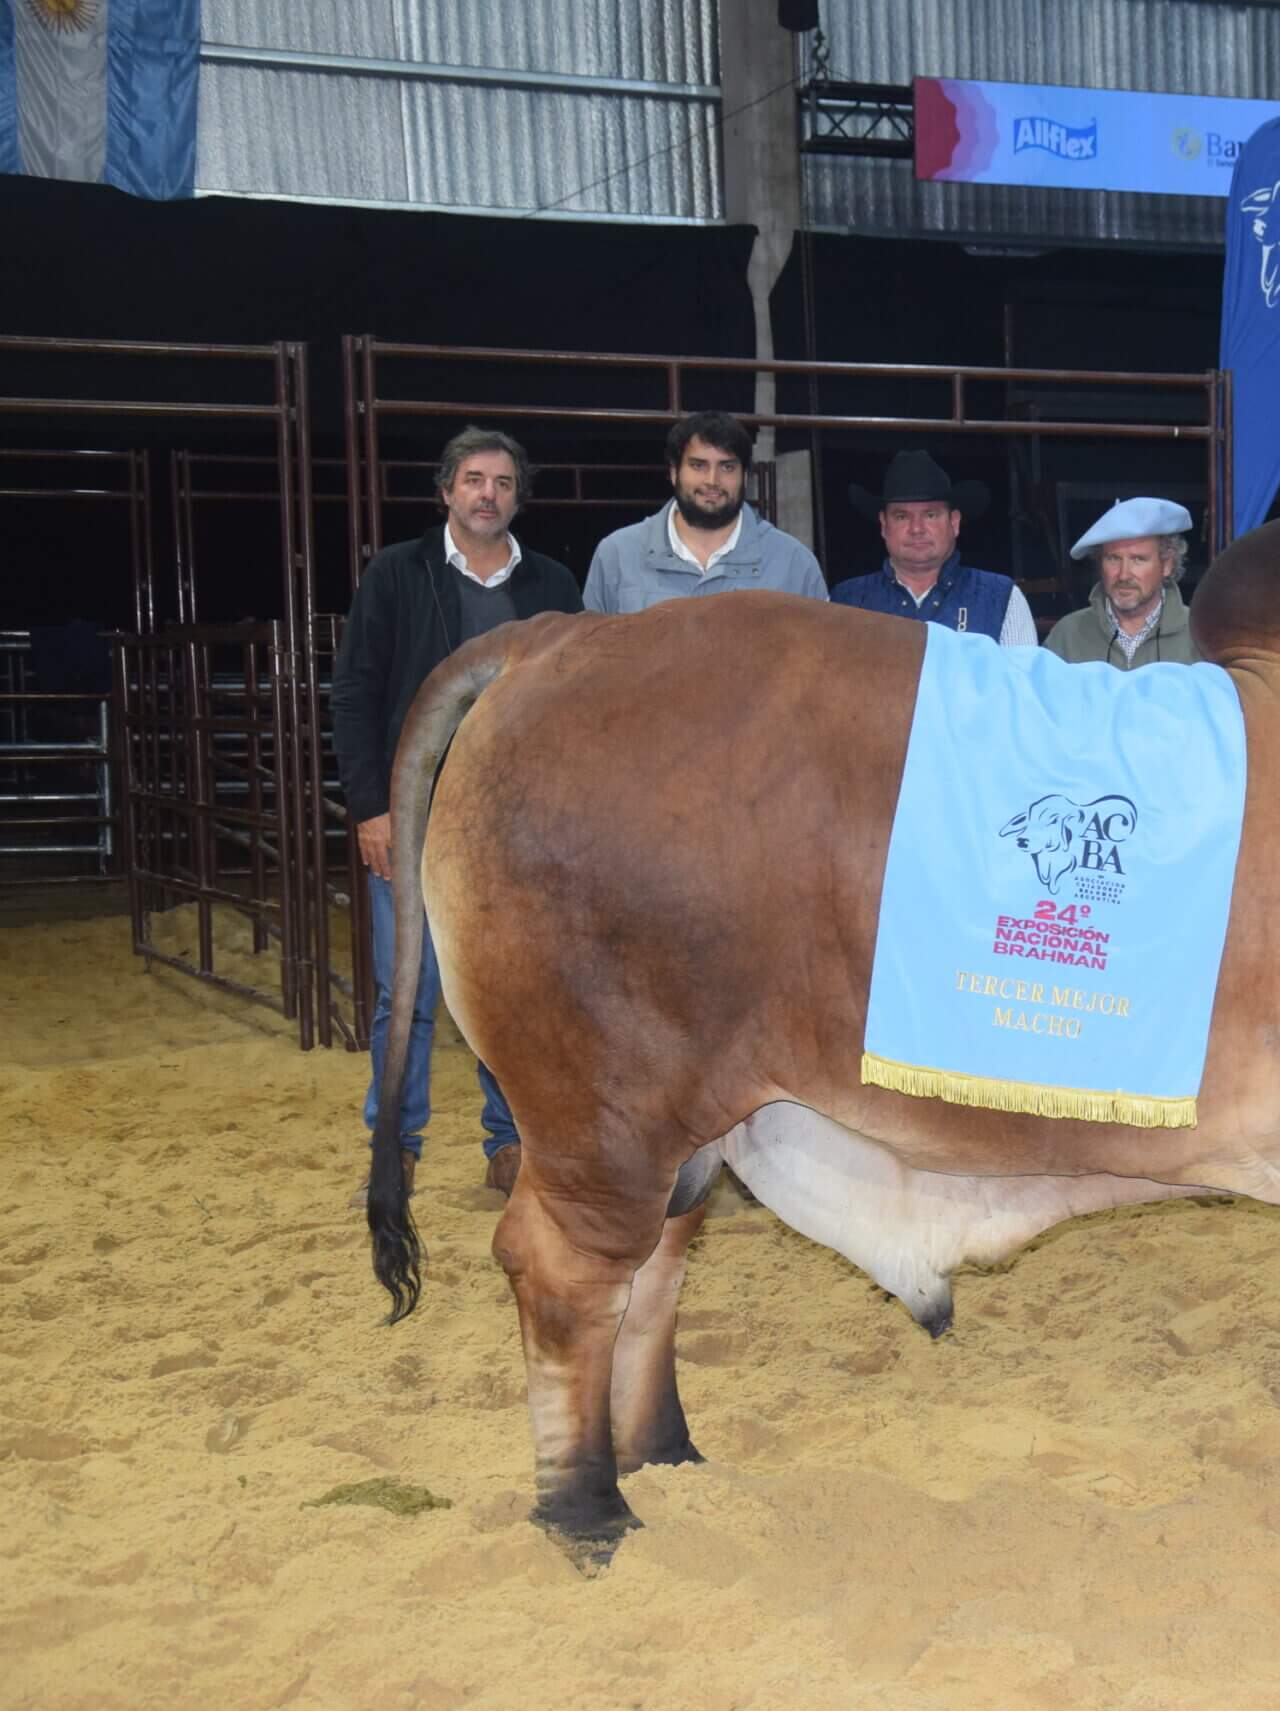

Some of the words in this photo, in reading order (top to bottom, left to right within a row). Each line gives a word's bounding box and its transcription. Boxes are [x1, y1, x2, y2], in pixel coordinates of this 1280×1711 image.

[1015, 118, 1096, 159] Allflex
[1079, 811, 1129, 843] AC
[1079, 839, 1126, 875] BA
[995, 927, 1108, 957] NACIONAL
[997, 915, 1110, 944] EXPOSICIÓN
[992, 941, 1107, 971] BRAHMAN
[956, 971, 1046, 1004] TERCER
[1051, 985, 1133, 1017] MEJOR
[992, 1007, 1082, 1040] MACHO
